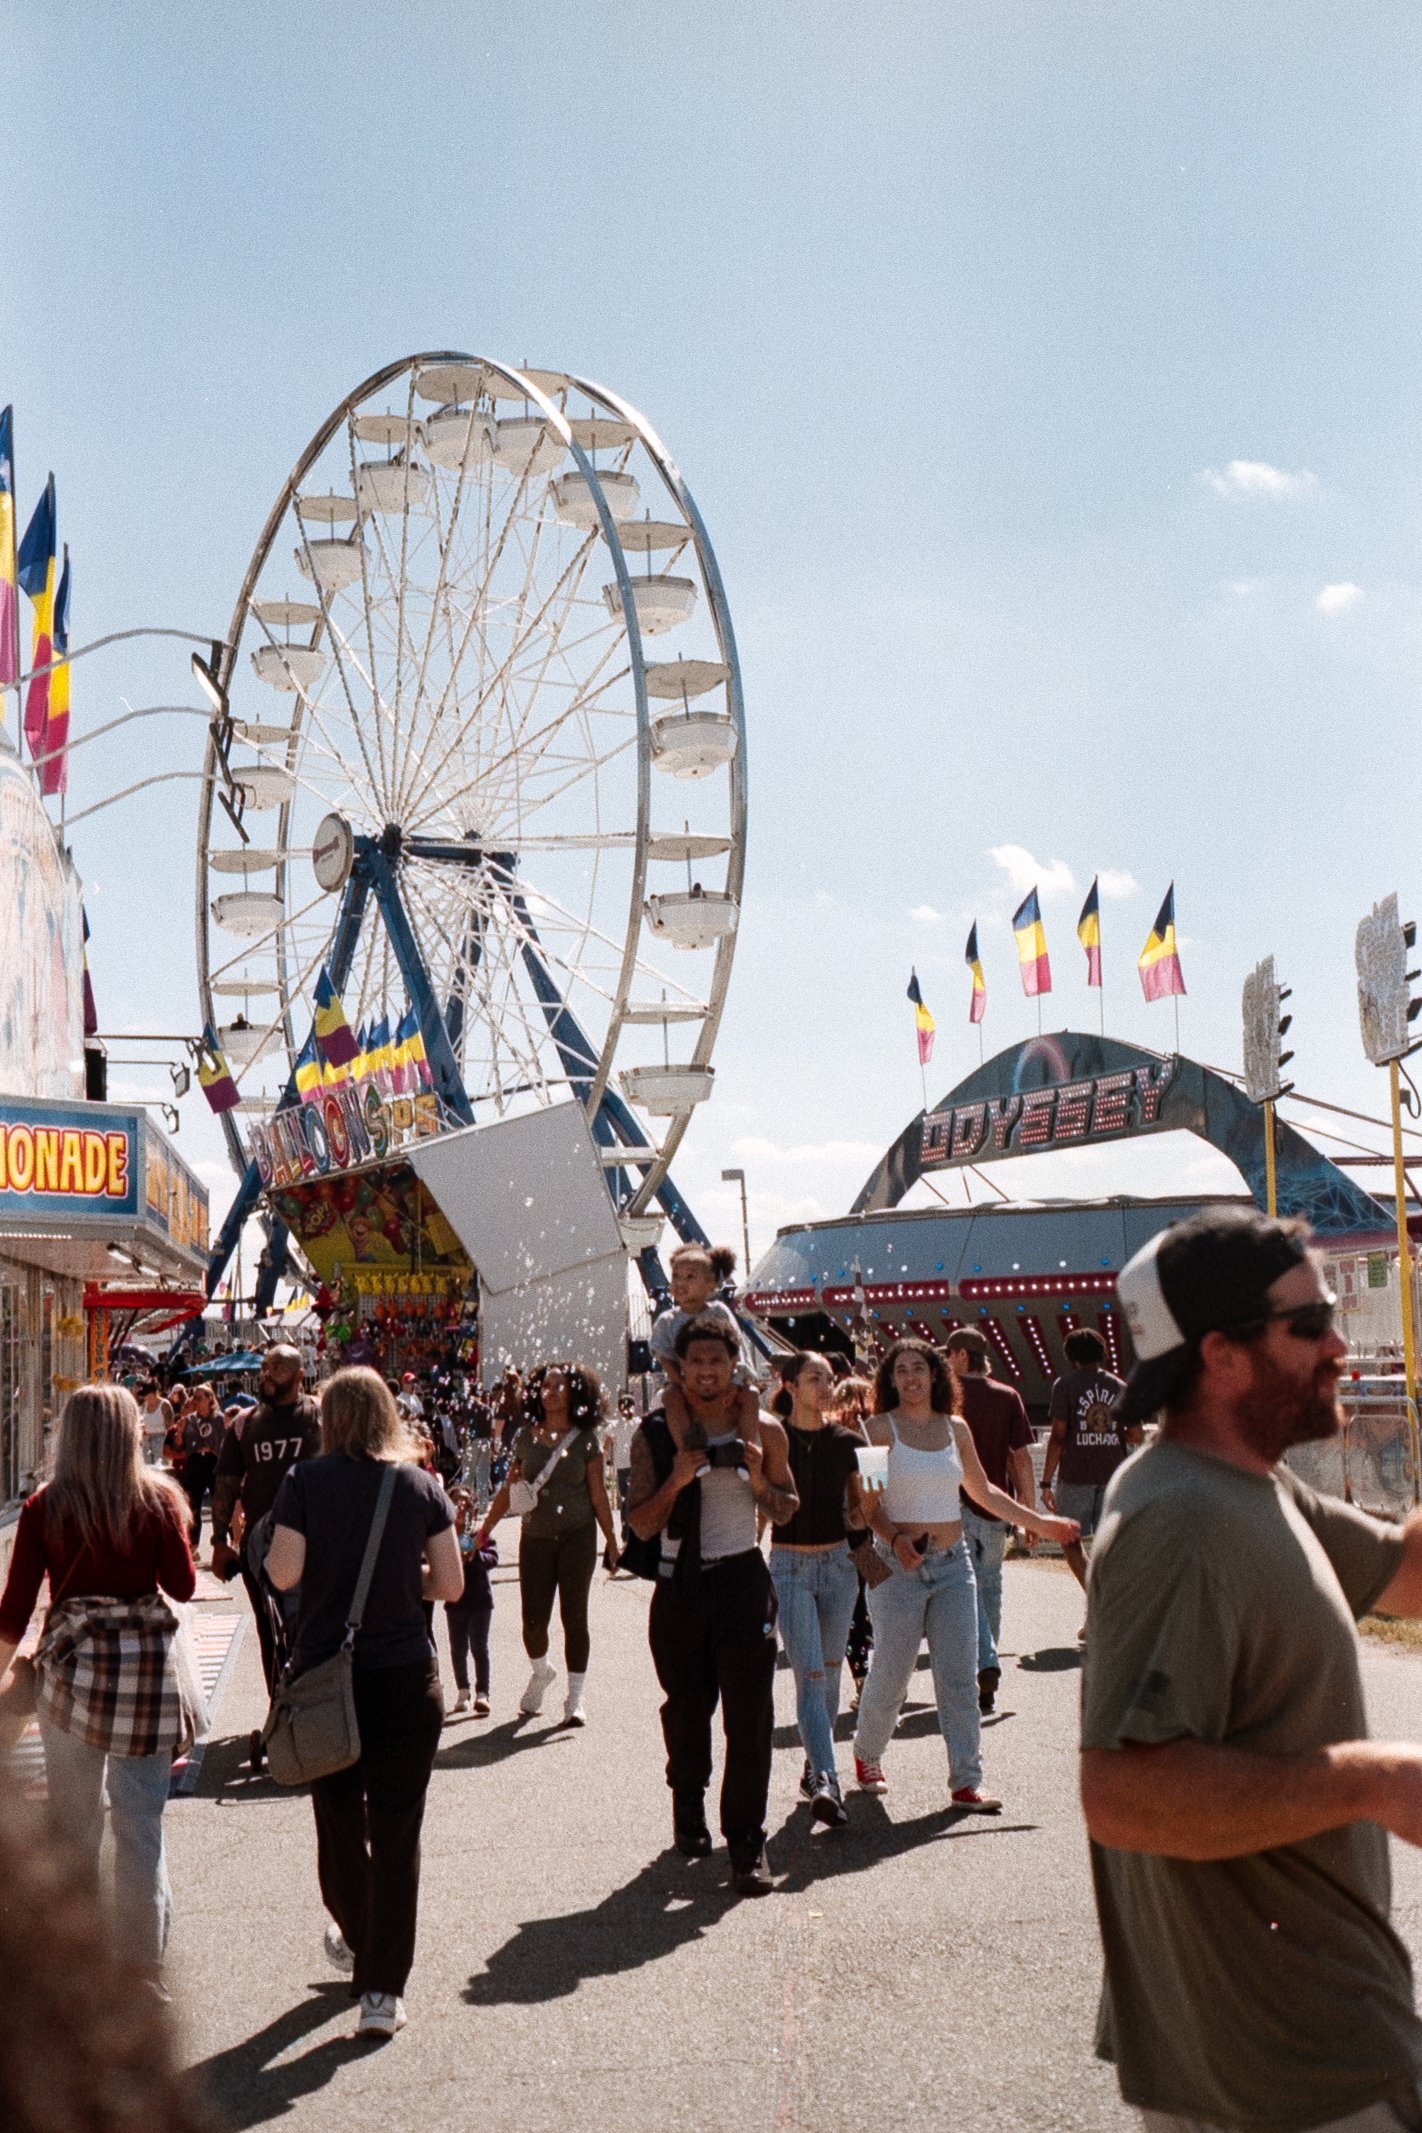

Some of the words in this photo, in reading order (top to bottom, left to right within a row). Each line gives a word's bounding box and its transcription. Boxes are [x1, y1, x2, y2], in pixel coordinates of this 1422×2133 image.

[248, 1083, 389, 1186] BALLOONS
[920, 1060, 1175, 1164] ODYSSEY
[0, 1123, 128, 1197] ONADE
[1077, 1383, 1119, 1417] ESPÍRI
[254, 1437, 302, 1462] 1977
